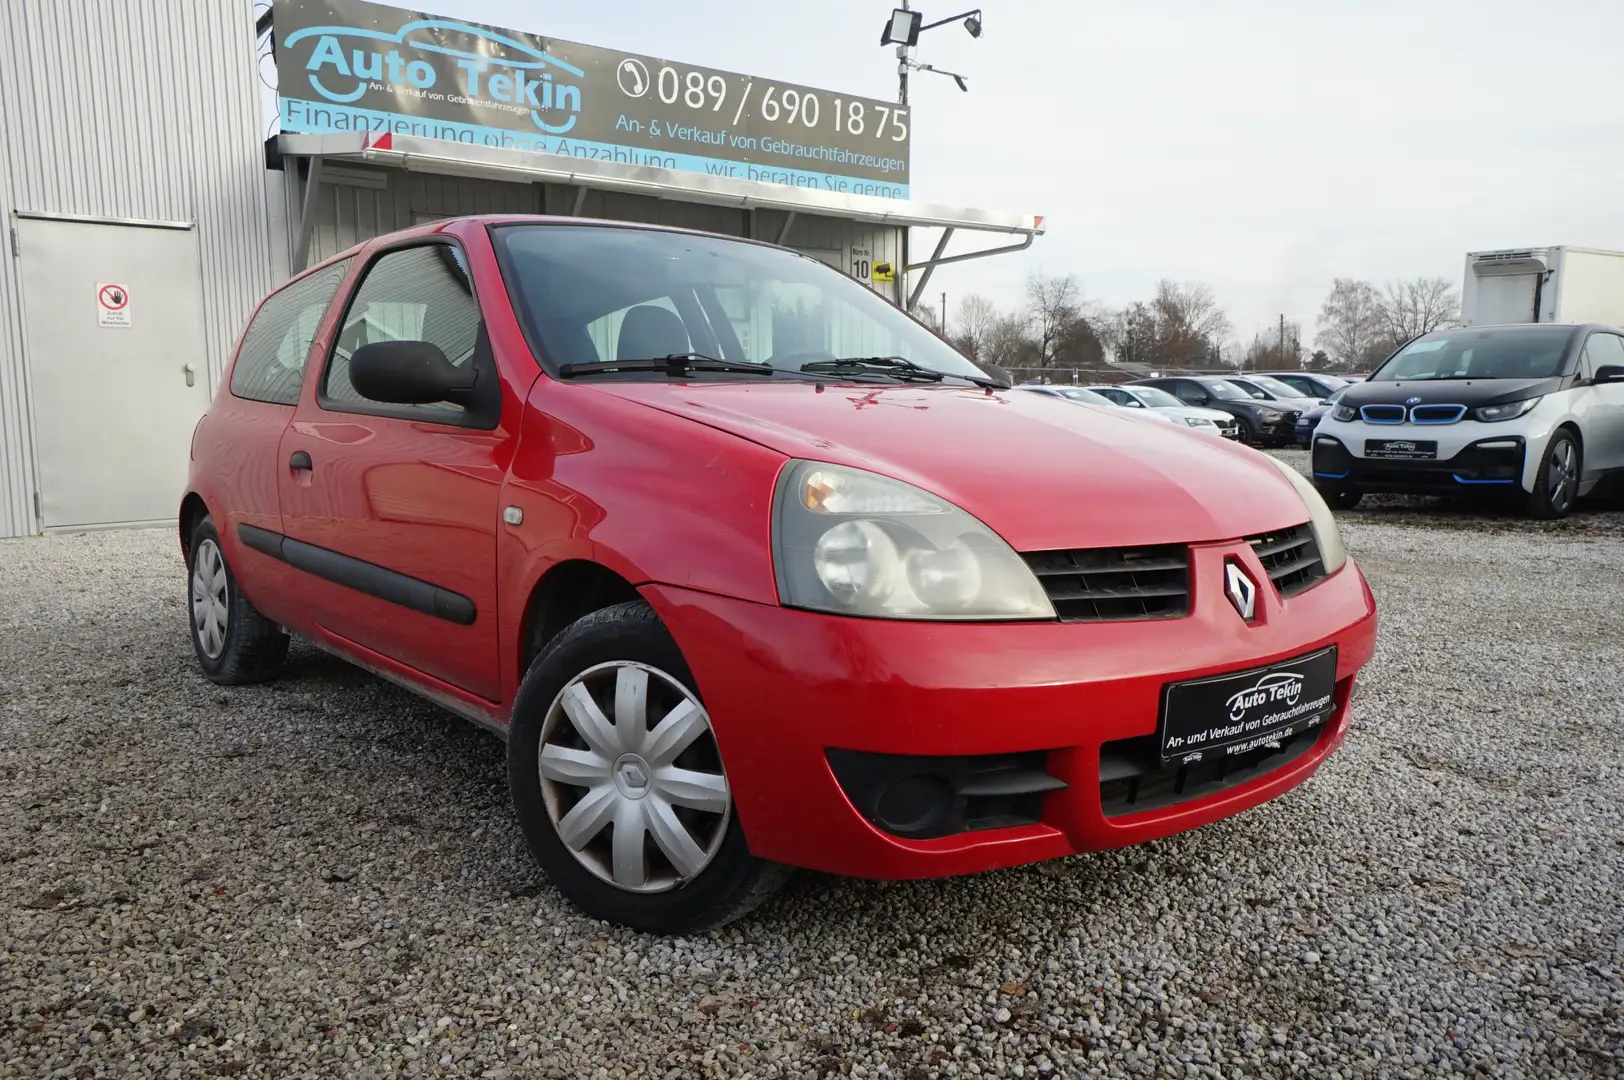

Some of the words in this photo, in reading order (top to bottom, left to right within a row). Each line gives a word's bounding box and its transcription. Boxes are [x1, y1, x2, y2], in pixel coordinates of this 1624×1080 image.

[305, 35, 437, 89] Auto
[457, 58, 581, 112] Tekin
[368, 81, 385, 91] An-
[386, 84, 393, 93] &
[394, 86, 427, 98] Verkauf
[428, 92, 444, 101] von
[447, 94, 530, 115] Gebrauchtfahrzeugen
[658, 66, 727, 112] 089
[732, 82, 753, 126] /
[761, 86, 820, 128] 690
[834, 98, 865, 135] 18
[874, 105, 909, 142] 75
[287, 100, 474, 143] Finanzierung
[748, 164, 818, 188] beraten
[824, 175, 848, 193] Sie
[615, 114, 645, 133] An-
[649, 119, 661, 136] &
[666, 121, 727, 145] Verkauf
[729, 135, 756, 150] von
[761, 136, 905, 173] Gebrauchtfahrzeugen
[853, 260, 868, 278] 10
[1166, 736, 1185, 749] An-
[1187, 730, 1207, 745] und
[1209, 721, 1245, 739] Verkauf
[1245, 720, 1260, 731] von
[1262, 694, 1330, 727] Gebrauchtfahrzeugen
[1231, 692, 1266, 711] Auto
[1269, 681, 1302, 702] Tekin
[1226, 727, 1293, 755] www.autotekin.de
